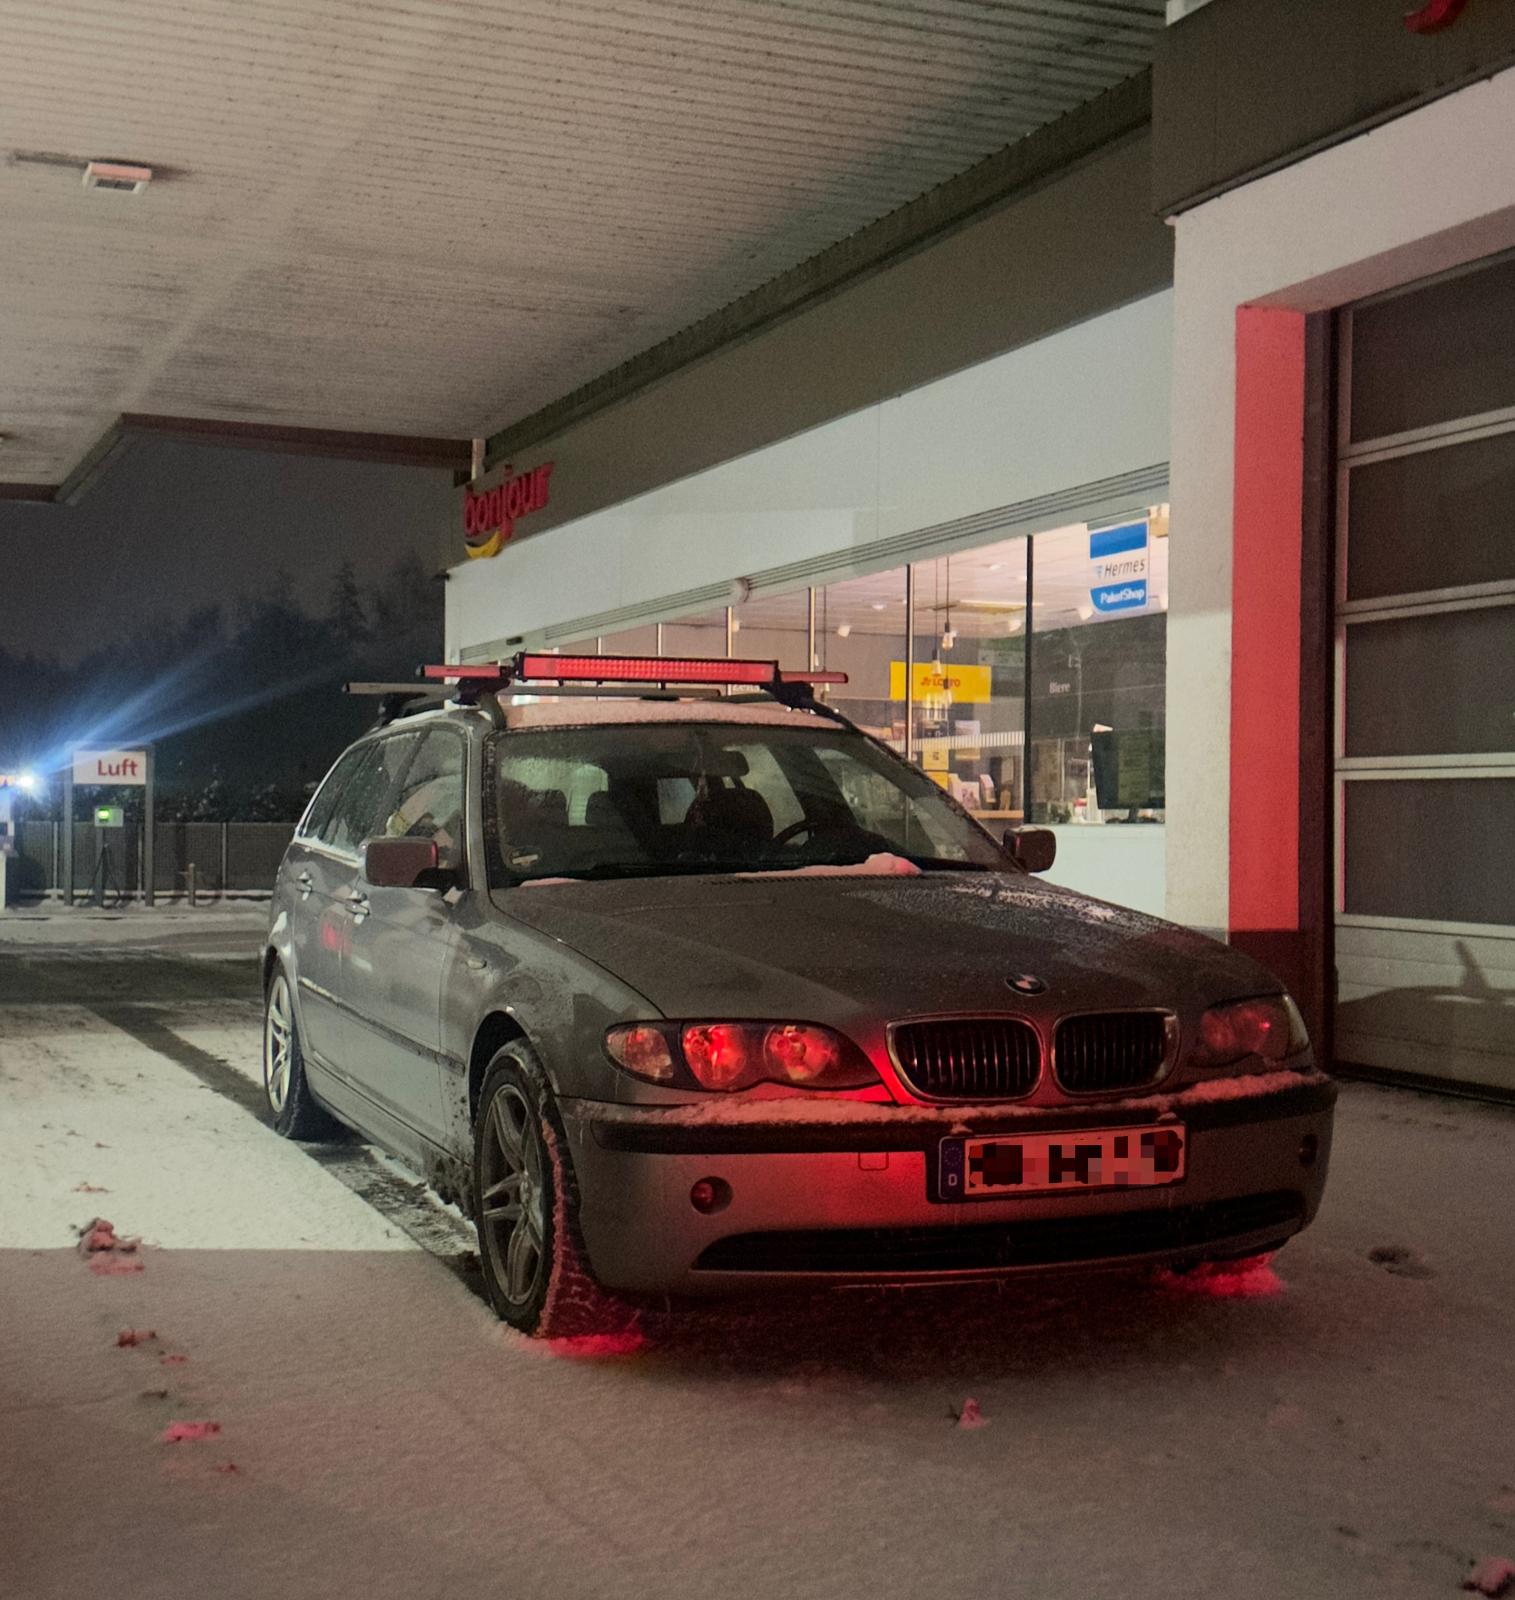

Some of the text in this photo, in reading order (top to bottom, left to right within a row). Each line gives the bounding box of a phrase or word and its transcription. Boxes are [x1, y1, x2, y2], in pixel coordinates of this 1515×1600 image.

[464, 461, 554, 540] bonjour
[1104, 559, 1145, 577] Hermes
[1101, 588, 1145, 604] PaketShop
[97, 758, 138, 777] Luft
[948, 1173, 958, 1186] D
